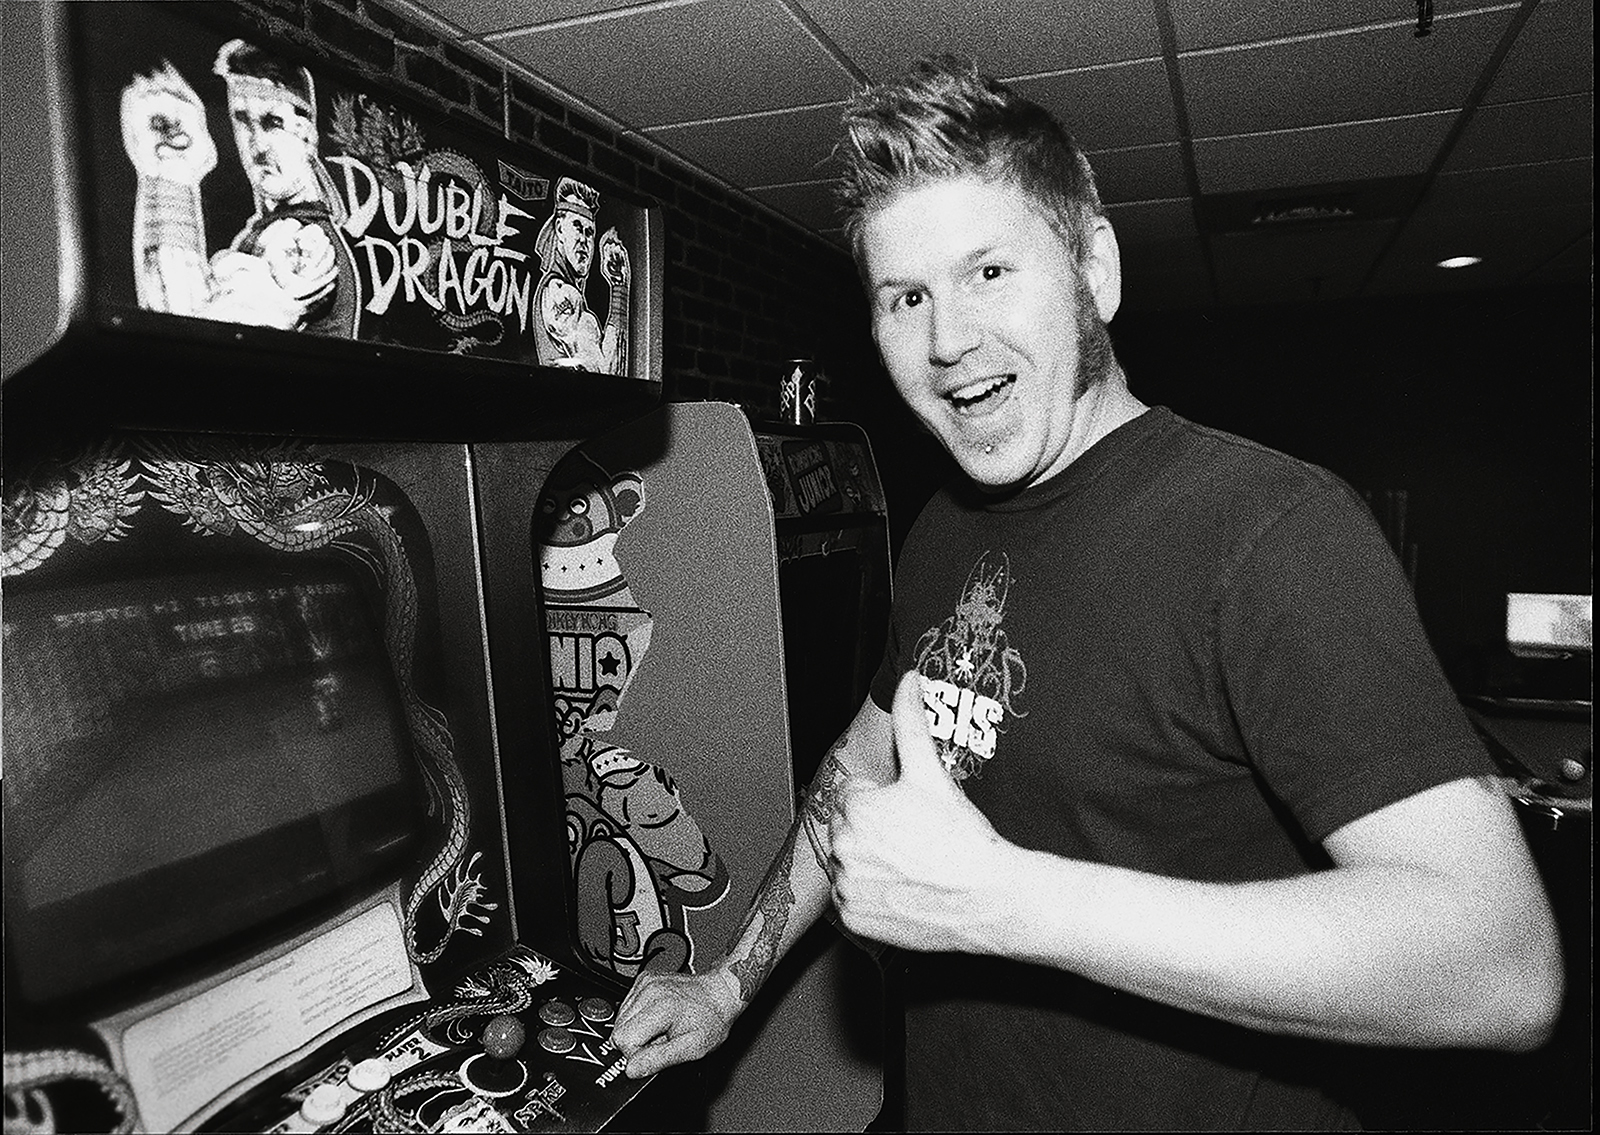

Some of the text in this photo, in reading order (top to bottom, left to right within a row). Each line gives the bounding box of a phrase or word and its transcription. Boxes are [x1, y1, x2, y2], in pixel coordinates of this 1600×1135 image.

[325, 152, 536, 262] DOUBLE
[355, 235, 532, 334] DRAGON
[174, 619, 228, 642] TIME
[922, 678, 1004, 759] SIS
[385, 1037, 421, 1062] PLAYER
[410, 1046, 432, 1061] 2
